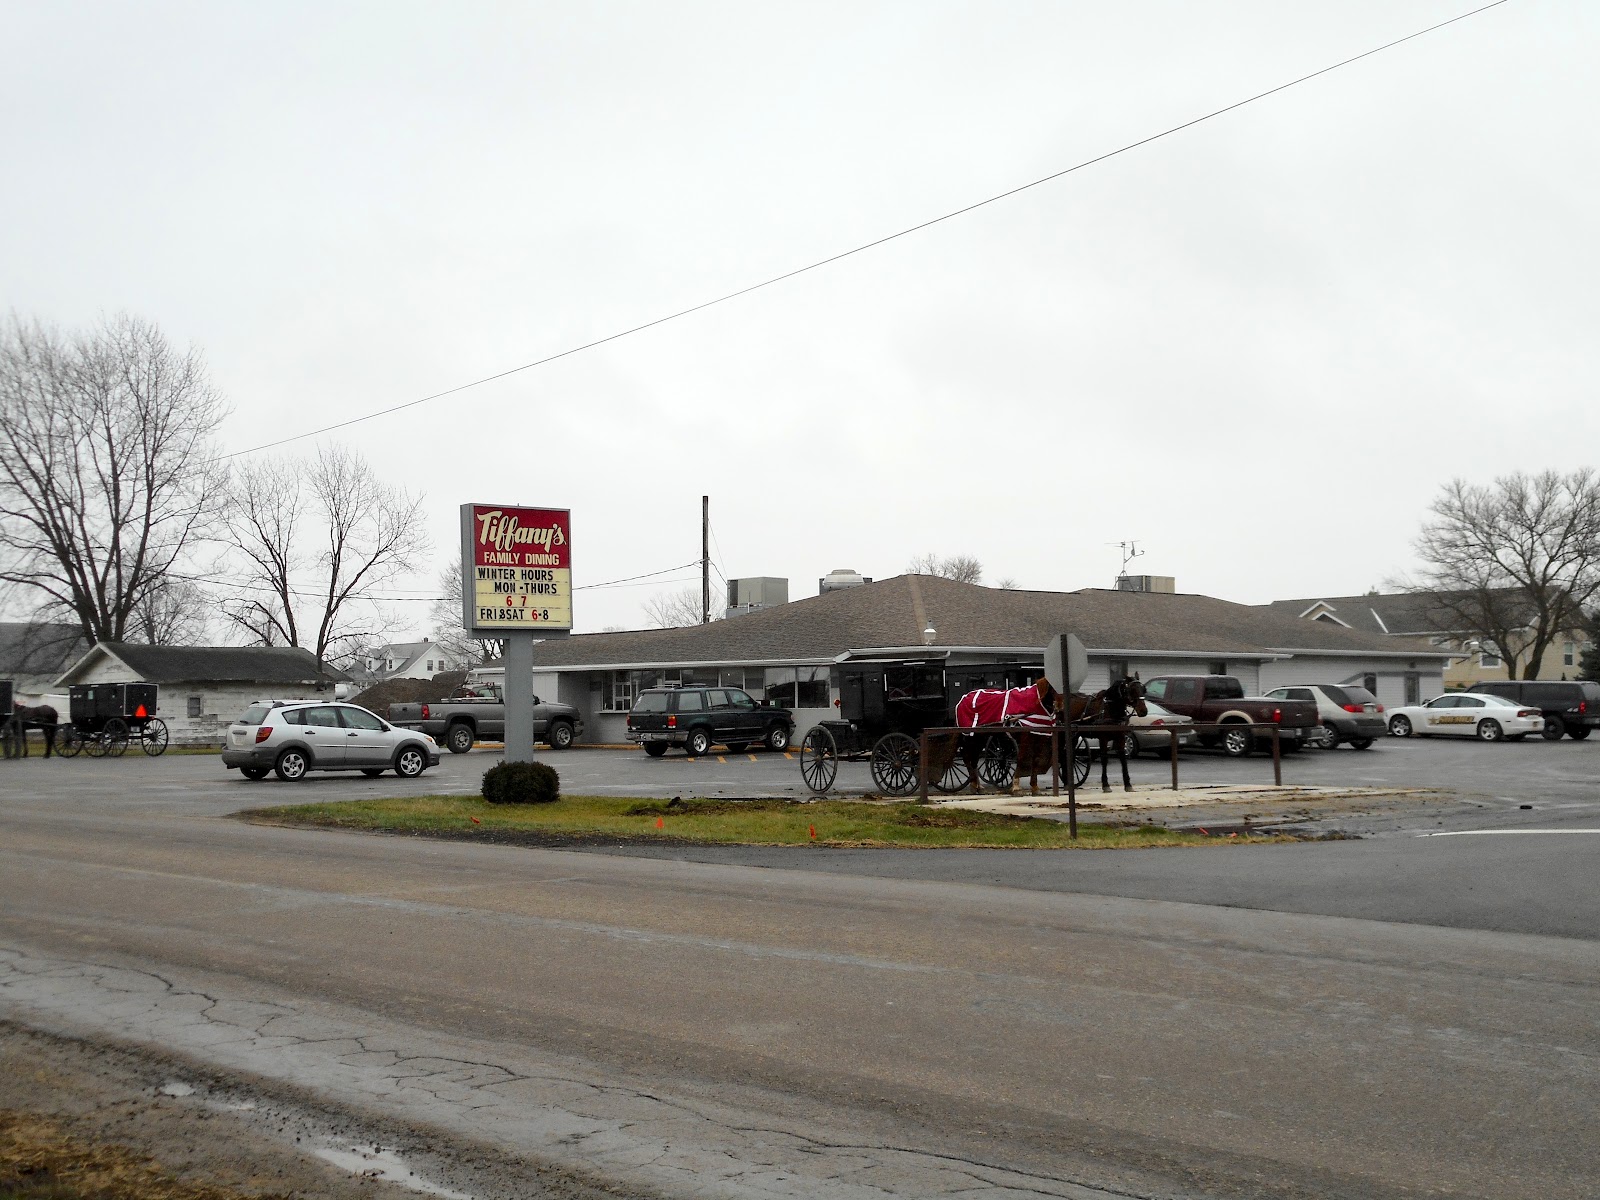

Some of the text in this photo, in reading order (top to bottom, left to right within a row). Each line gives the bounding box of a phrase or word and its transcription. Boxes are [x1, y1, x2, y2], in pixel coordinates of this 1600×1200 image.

[476, 510, 567, 553] Tiffany's
[484, 551, 560, 566] FAMILY DINING
[478, 567, 554, 581] WINTER HOURS
[494, 581, 516, 593] MON
[506, 595, 527, 607] 6 7
[531, 609, 549, 621] 6-8
